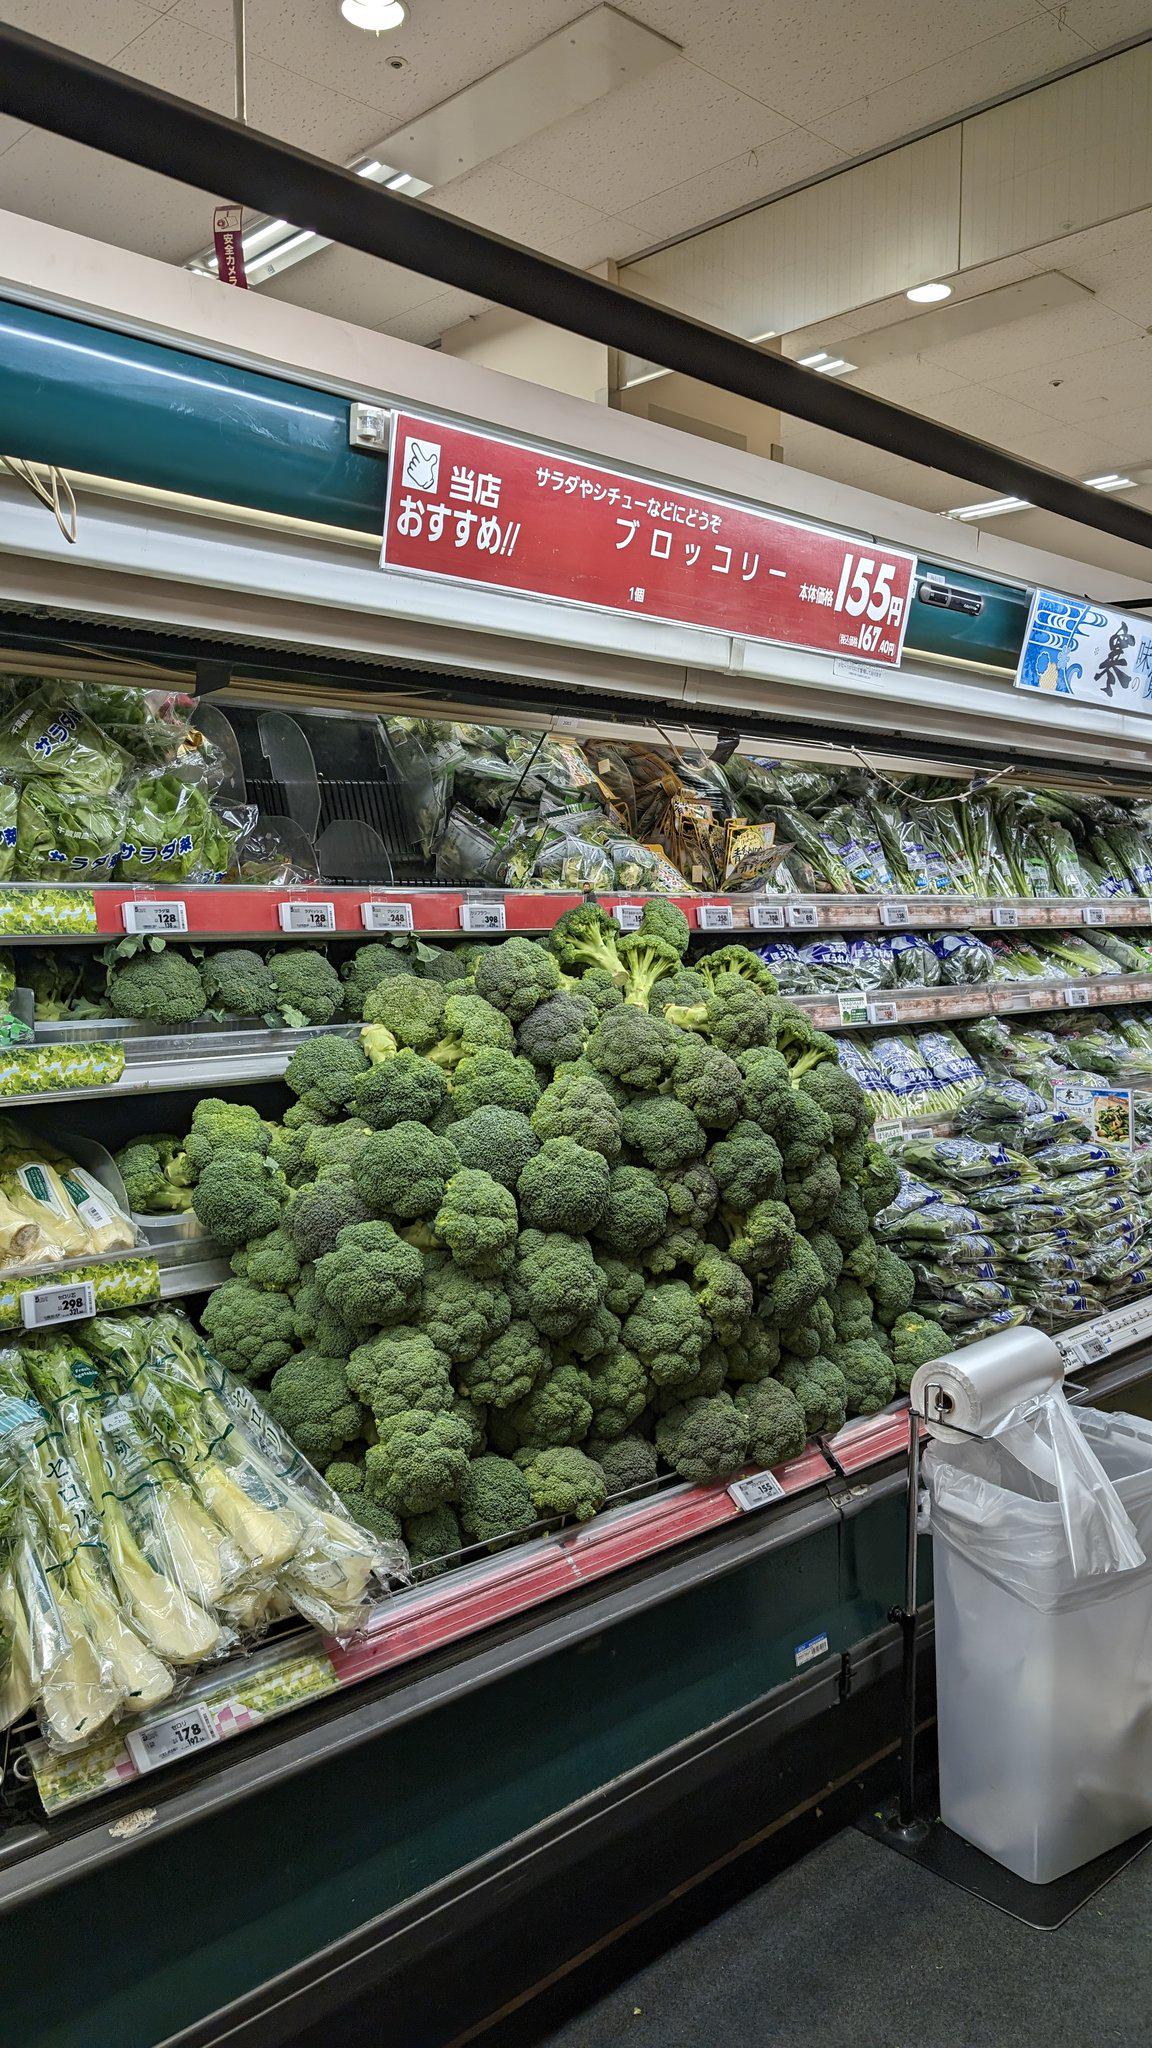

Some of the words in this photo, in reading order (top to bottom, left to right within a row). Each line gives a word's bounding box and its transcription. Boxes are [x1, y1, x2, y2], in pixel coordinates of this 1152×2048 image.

[450, 465, 501, 509] 当店
[535, 466, 723, 535] サラダやシチューなどにどうぞ
[615, 519, 787, 582] ブロッコリー
[628, 587, 646, 604] 1個
[834, 553, 904, 627] 155円
[0, 826, 17, 848] 菜
[119, 833, 193, 864] サラダ菜
[158, 914, 176, 923] 128
[310, 914, 326, 922] 128
[390, 914, 404, 922] 248
[484, 915, 498, 923] 398
[62, 1297, 83, 1310] 298
[232, 1390, 282, 1453] セロリ
[47, 1458, 86, 1537] セロリ
[758, 1483, 773, 1493] 155
[171, 1720, 187, 1730] セロリ
[175, 1723, 201, 1742] 178
